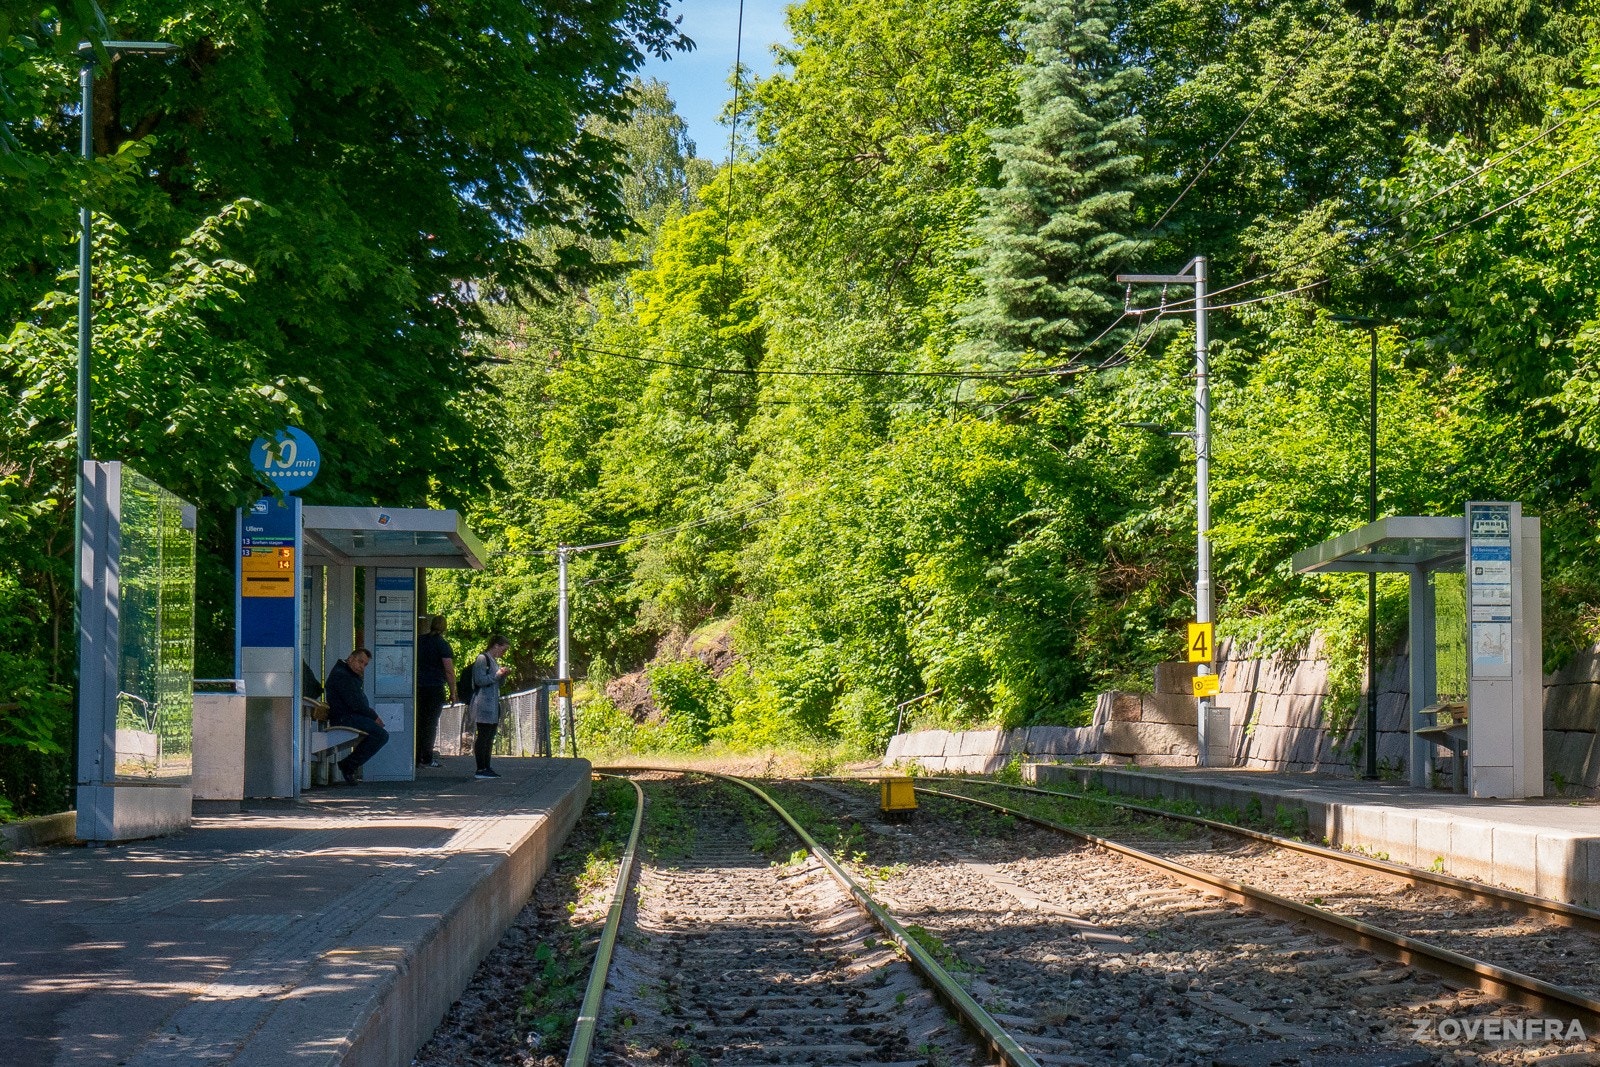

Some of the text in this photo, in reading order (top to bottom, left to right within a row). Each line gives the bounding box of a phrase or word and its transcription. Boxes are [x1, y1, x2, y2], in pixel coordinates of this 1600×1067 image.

[261, 439, 317, 469] 10 min
[283, 549, 290, 557] 5
[279, 560, 290, 569] 14
[1192, 630, 1208, 658] 4
